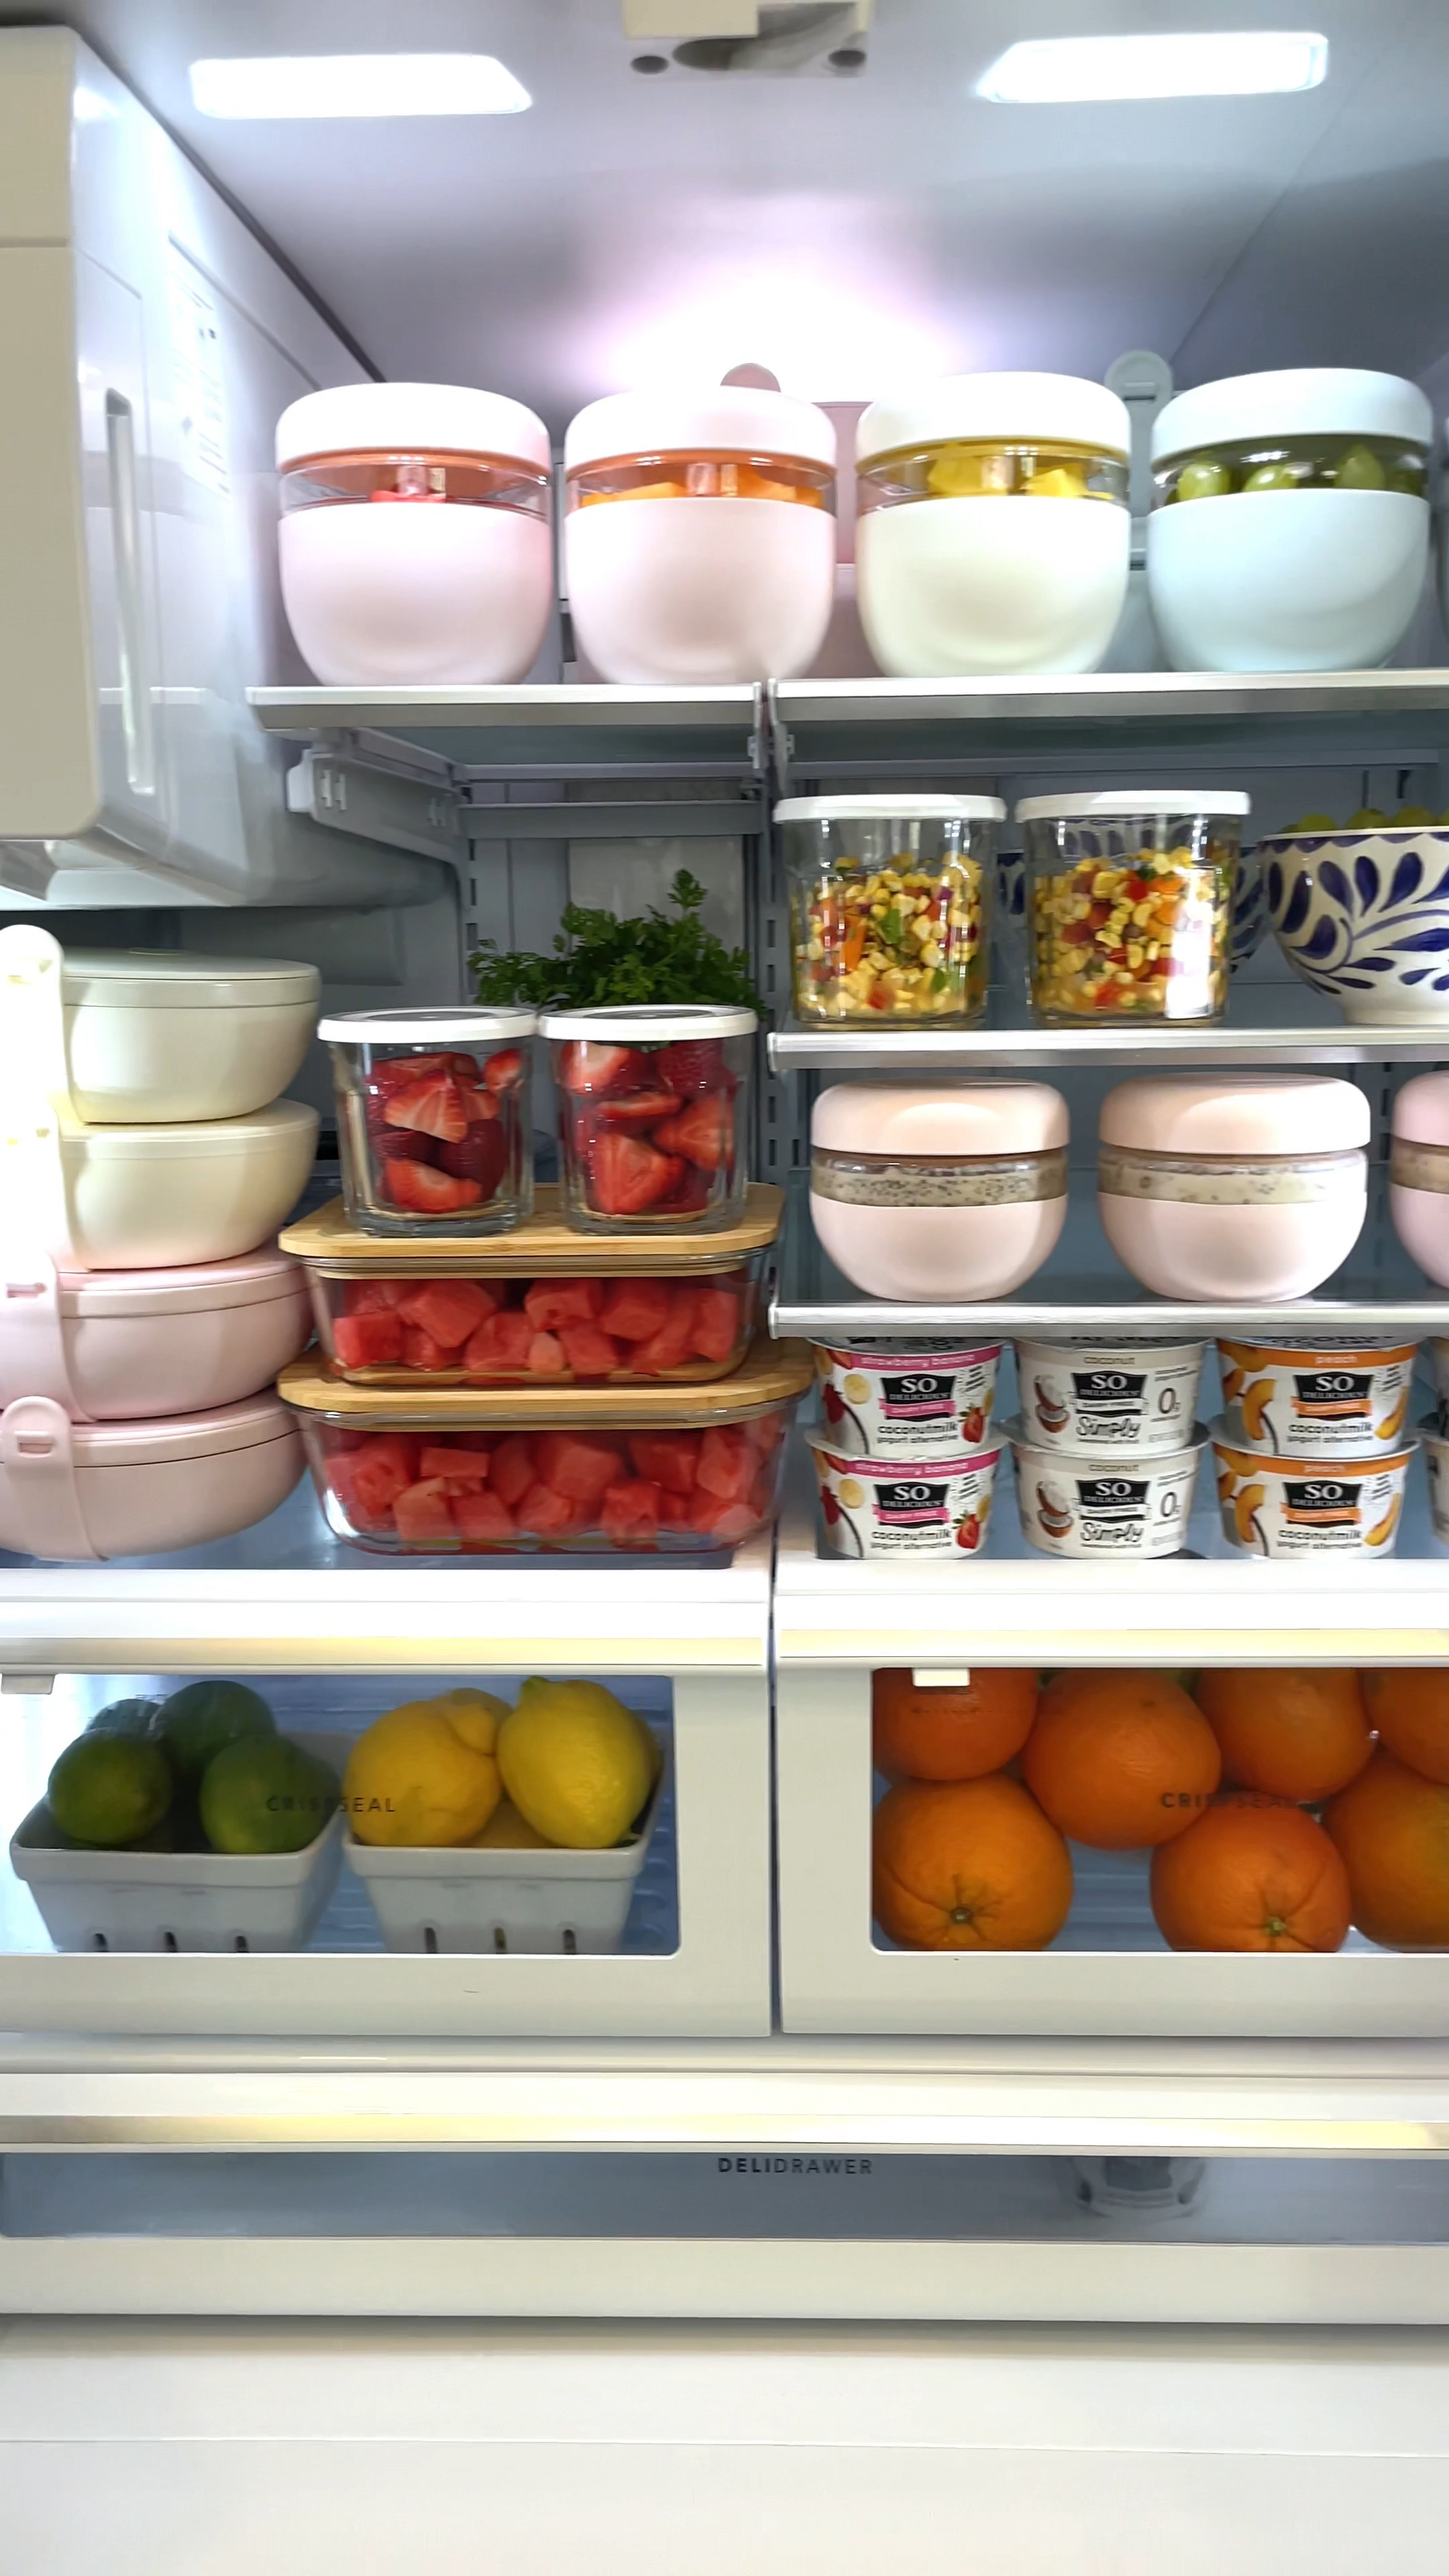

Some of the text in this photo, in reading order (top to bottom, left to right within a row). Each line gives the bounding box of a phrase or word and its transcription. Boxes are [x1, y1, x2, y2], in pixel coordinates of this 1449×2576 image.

[901, 1378, 938, 1393] SO
[1091, 1375, 1128, 1389] SO
[1315, 1376, 1354, 1391] SO
[1076, 1416, 1141, 1438] Simply
[894, 1485, 931, 1501] SO
[1095, 1482, 1132, 1497] SO
[1304, 1484, 1344, 1499] SO
[1080, 1522, 1144, 1543] Simply
[718, 2157, 872, 2174] DELIDRAWER
